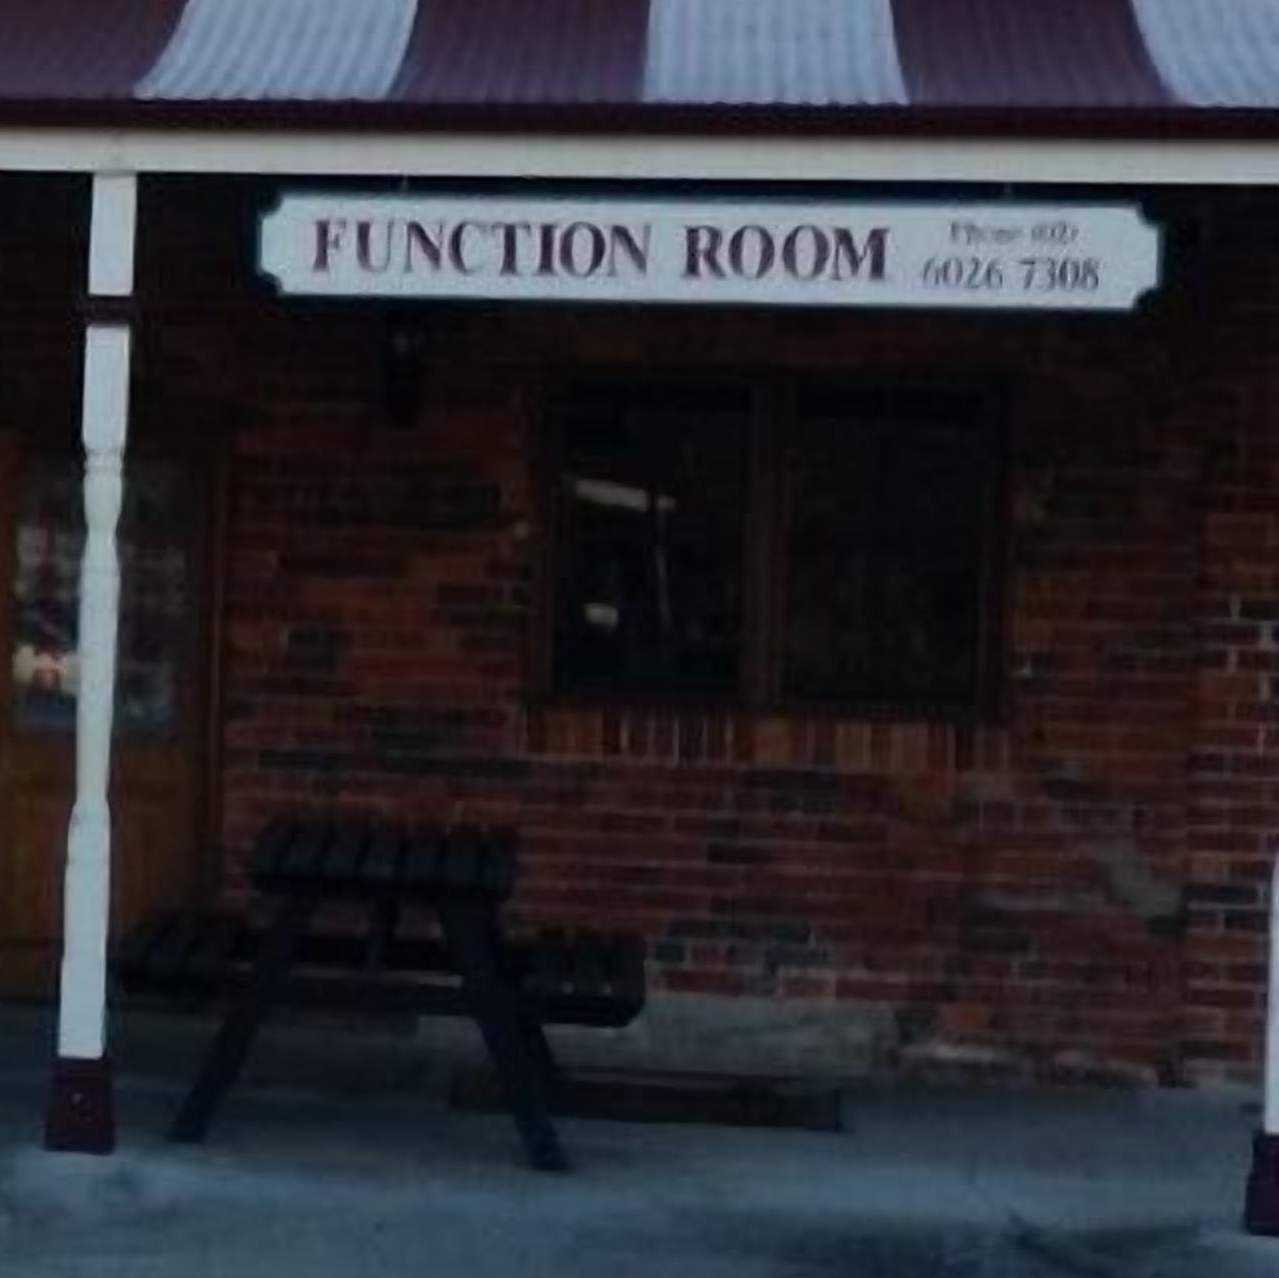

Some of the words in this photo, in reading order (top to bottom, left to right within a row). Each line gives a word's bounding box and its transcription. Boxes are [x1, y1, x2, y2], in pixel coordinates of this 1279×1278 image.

[310, 218, 649, 277] FUNCTION
[682, 223, 893, 283] ROOM
[922, 254, 1005, 291] 6026
[1019, 255, 1103, 291] 7308
